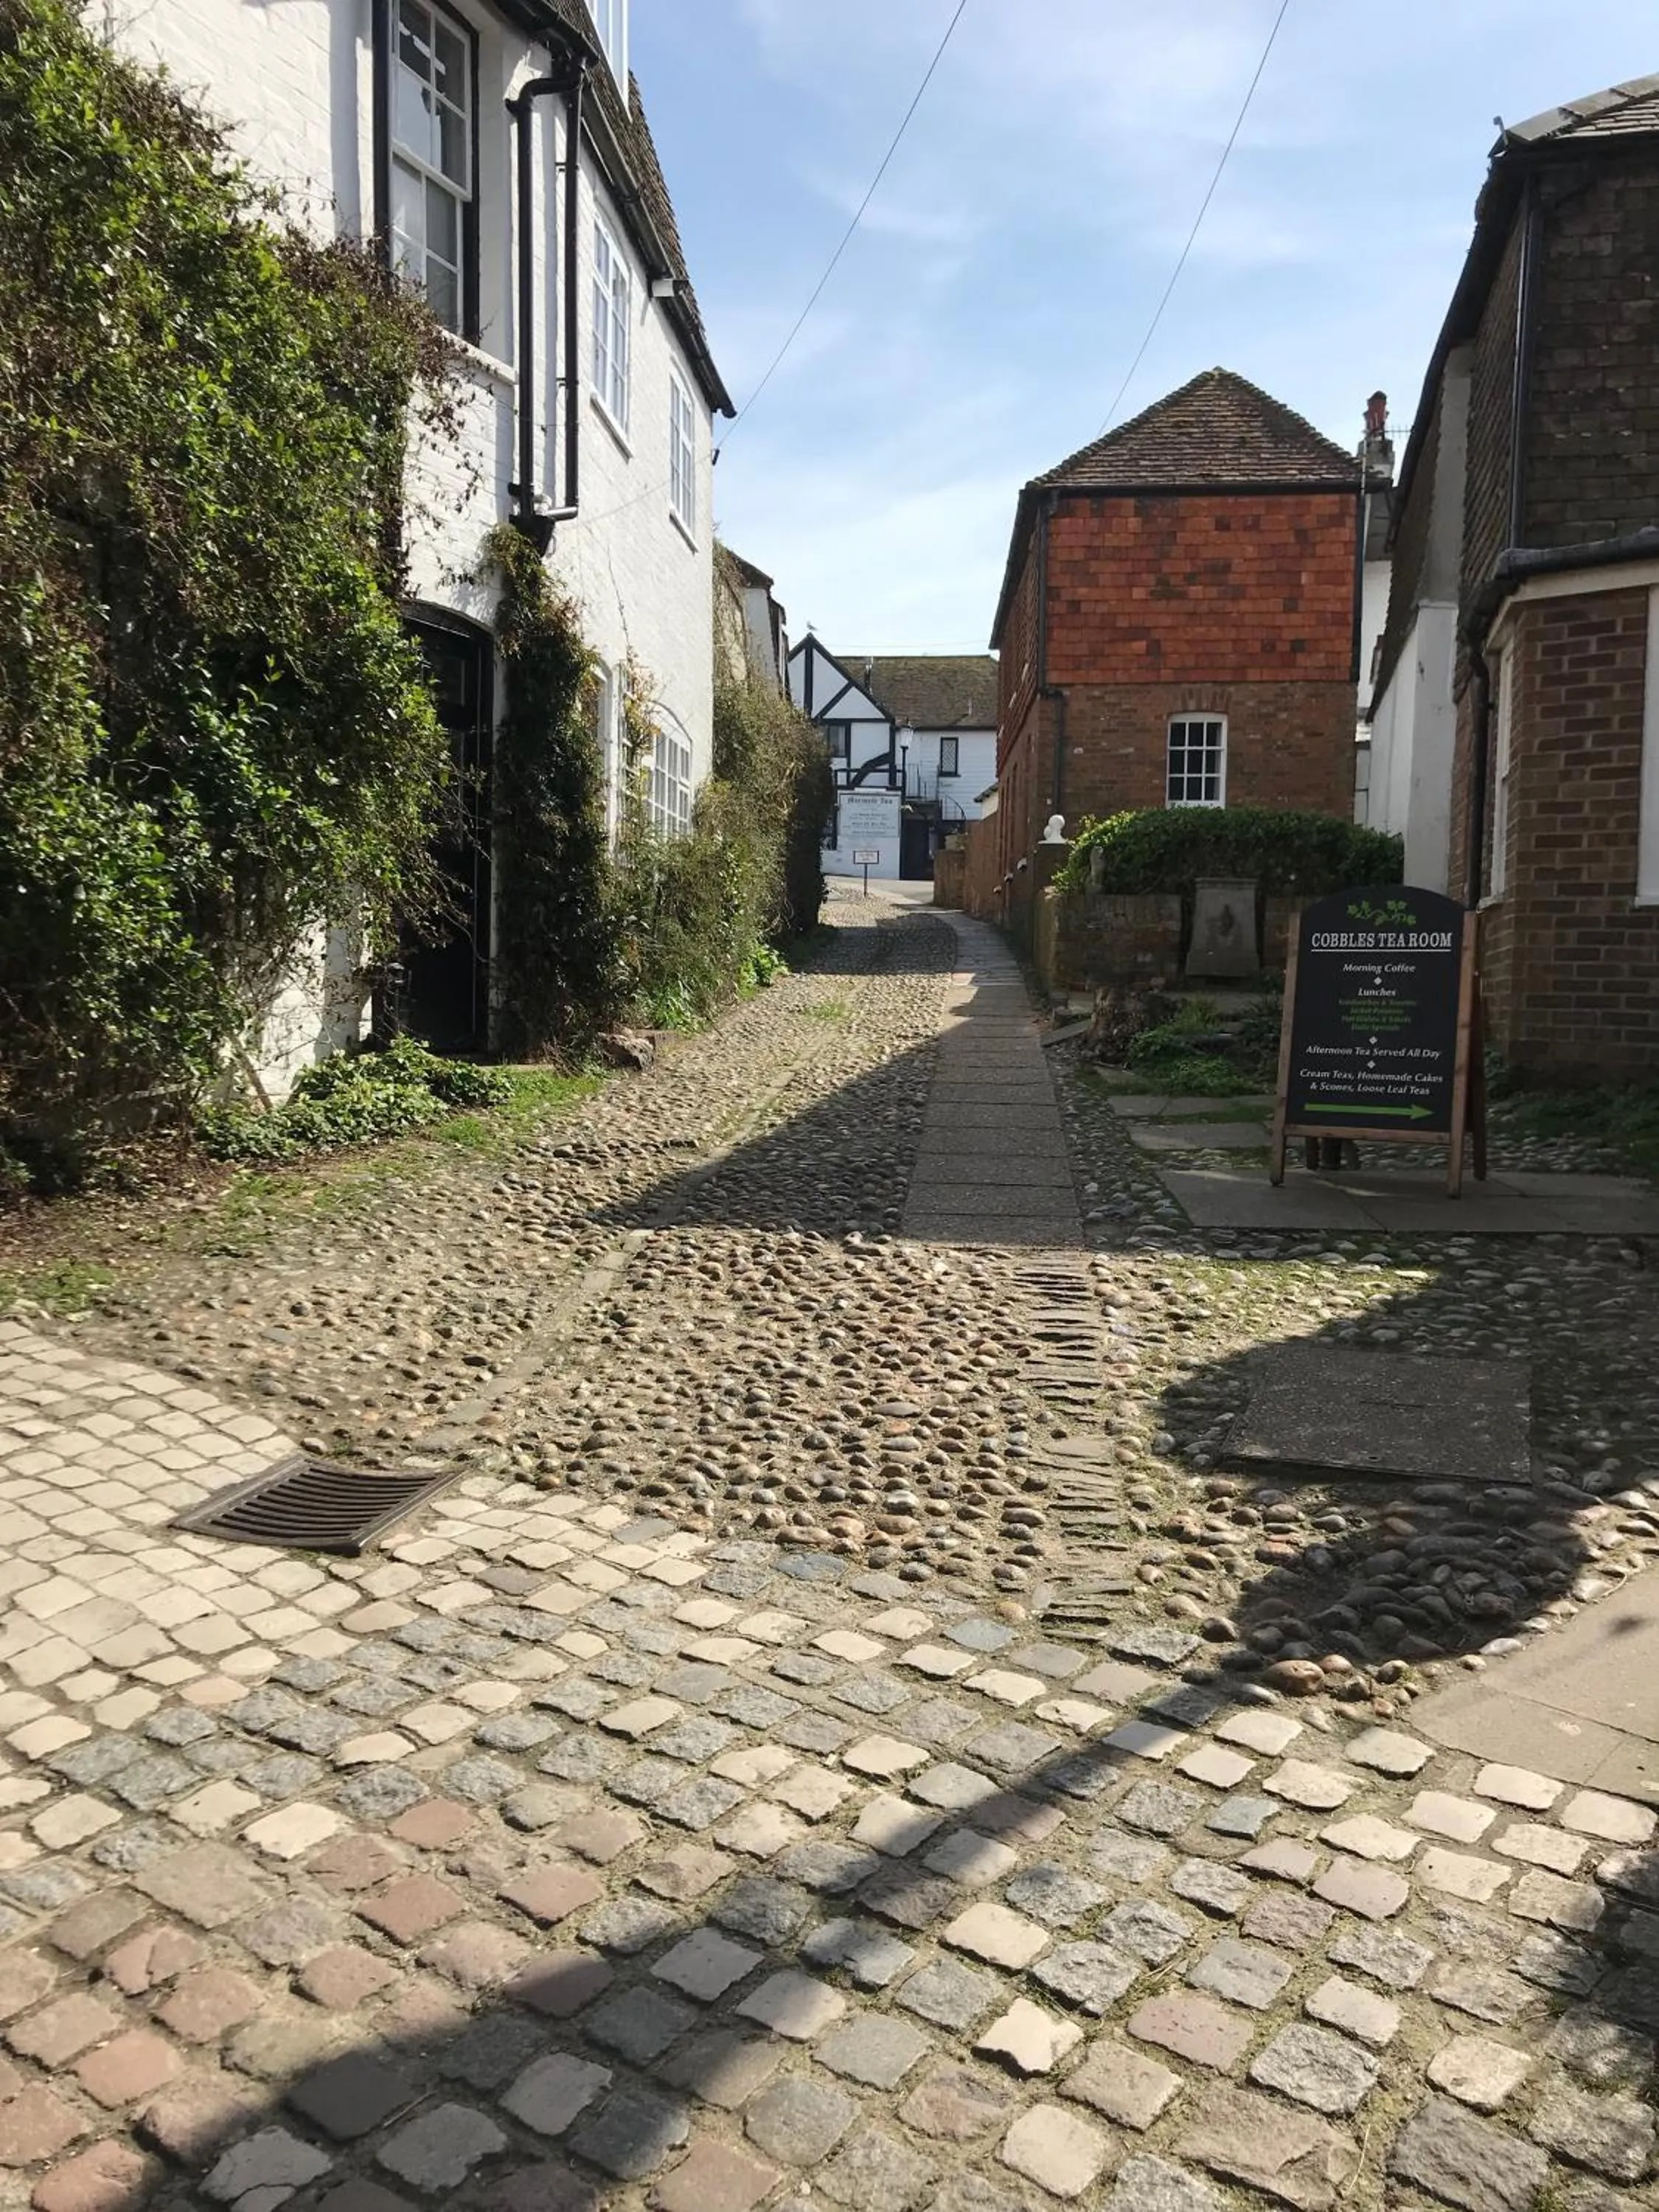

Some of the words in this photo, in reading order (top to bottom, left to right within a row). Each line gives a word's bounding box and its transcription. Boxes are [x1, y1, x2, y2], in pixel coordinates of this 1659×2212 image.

[1311, 932, 1375, 947] COBBLES
[1378, 932, 1406, 947] TEA
[1409, 932, 1453, 947] ROOM
[1343, 963, 1382, 975] Morning
[1384, 963, 1416, 973] Coffee
[1357, 987, 1396, 996] Lunches
[1305, 1045, 1352, 1055] Afternoon
[1354, 1047, 1370, 1056] Tea
[1372, 1047, 1405, 1057] Served
[1406, 1048, 1420, 1057] All
[1422, 1048, 1441, 1060] Day
[1299, 1068, 1330, 1078] Cream
[1332, 1070, 1354, 1080] Teas,
[1357, 1071, 1413, 1082] Homemade
[1414, 1073, 1443, 1083] Cakes
[1310, 1082, 1317, 1091] &
[1319, 1082, 1354, 1092] Scones,
[1357, 1083, 1385, 1093] Loose
[1387, 1085, 1408, 1093] Leaf
[1409, 1086, 1430, 1096] Teas
